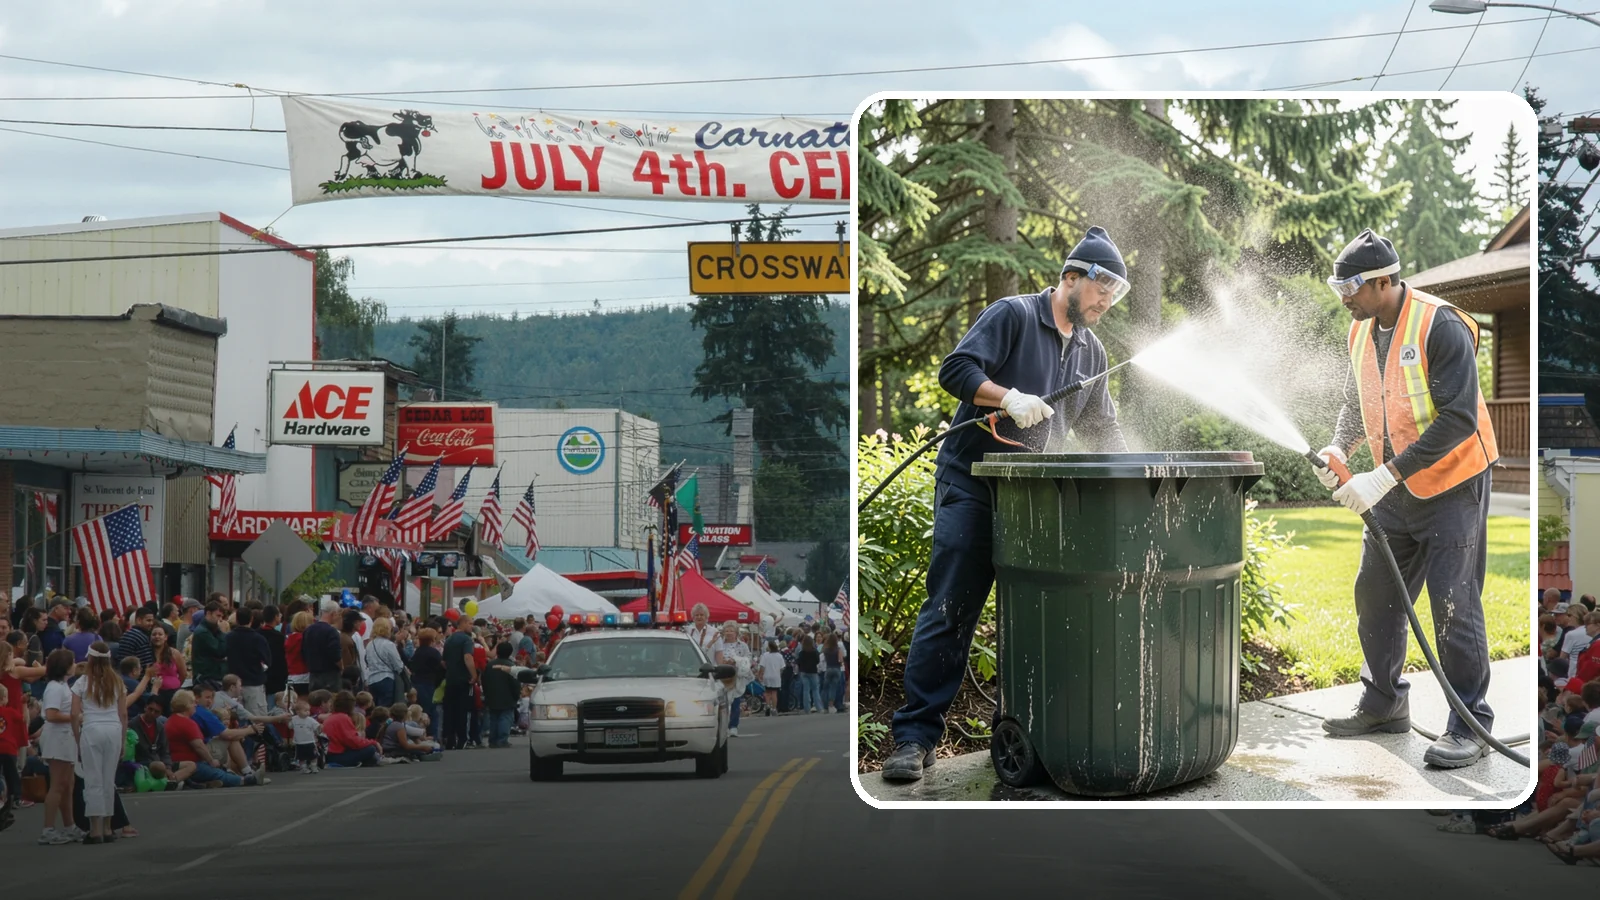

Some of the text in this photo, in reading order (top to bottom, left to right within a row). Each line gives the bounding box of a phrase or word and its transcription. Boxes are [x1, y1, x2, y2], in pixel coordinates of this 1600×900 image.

[481, 141, 604, 193] JULY
[632, 150, 747, 198] 4th.
[696, 254, 850, 280] CROSSWA
[284, 381, 373, 420] ACE
[405, 408, 452, 422] CEDAR
[283, 421, 371, 437] Hardware
[95, 484, 124, 495] Vincent
[126, 485, 136, 495] de
[137, 485, 155, 496] Paul
[212, 516, 331, 536] HARDARE
[688, 526, 741, 535] CRNATION
[699, 535, 730, 543] GLASS
